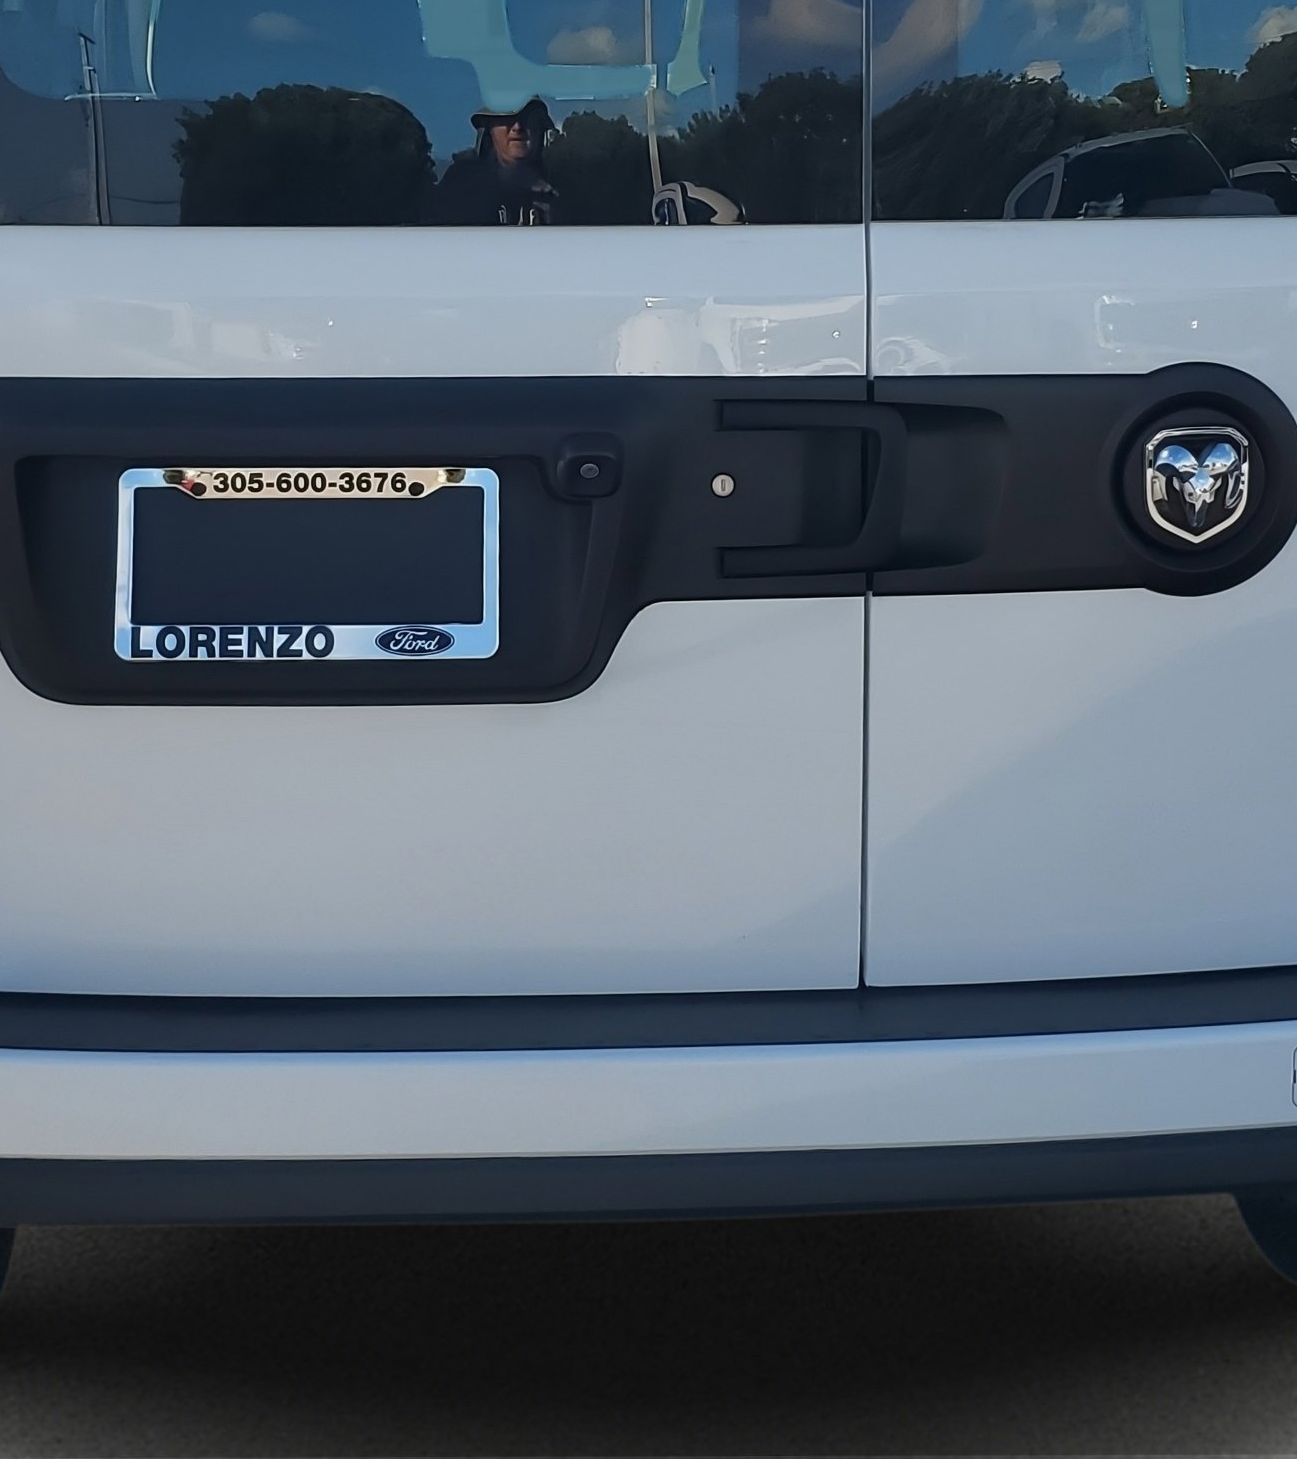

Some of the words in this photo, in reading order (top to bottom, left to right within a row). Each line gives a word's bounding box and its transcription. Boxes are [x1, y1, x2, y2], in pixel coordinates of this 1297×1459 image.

[213, 472, 407, 494] 305-600-3676
[130, 625, 334, 659] LORENZO
[389, 627, 440, 652] Ford
